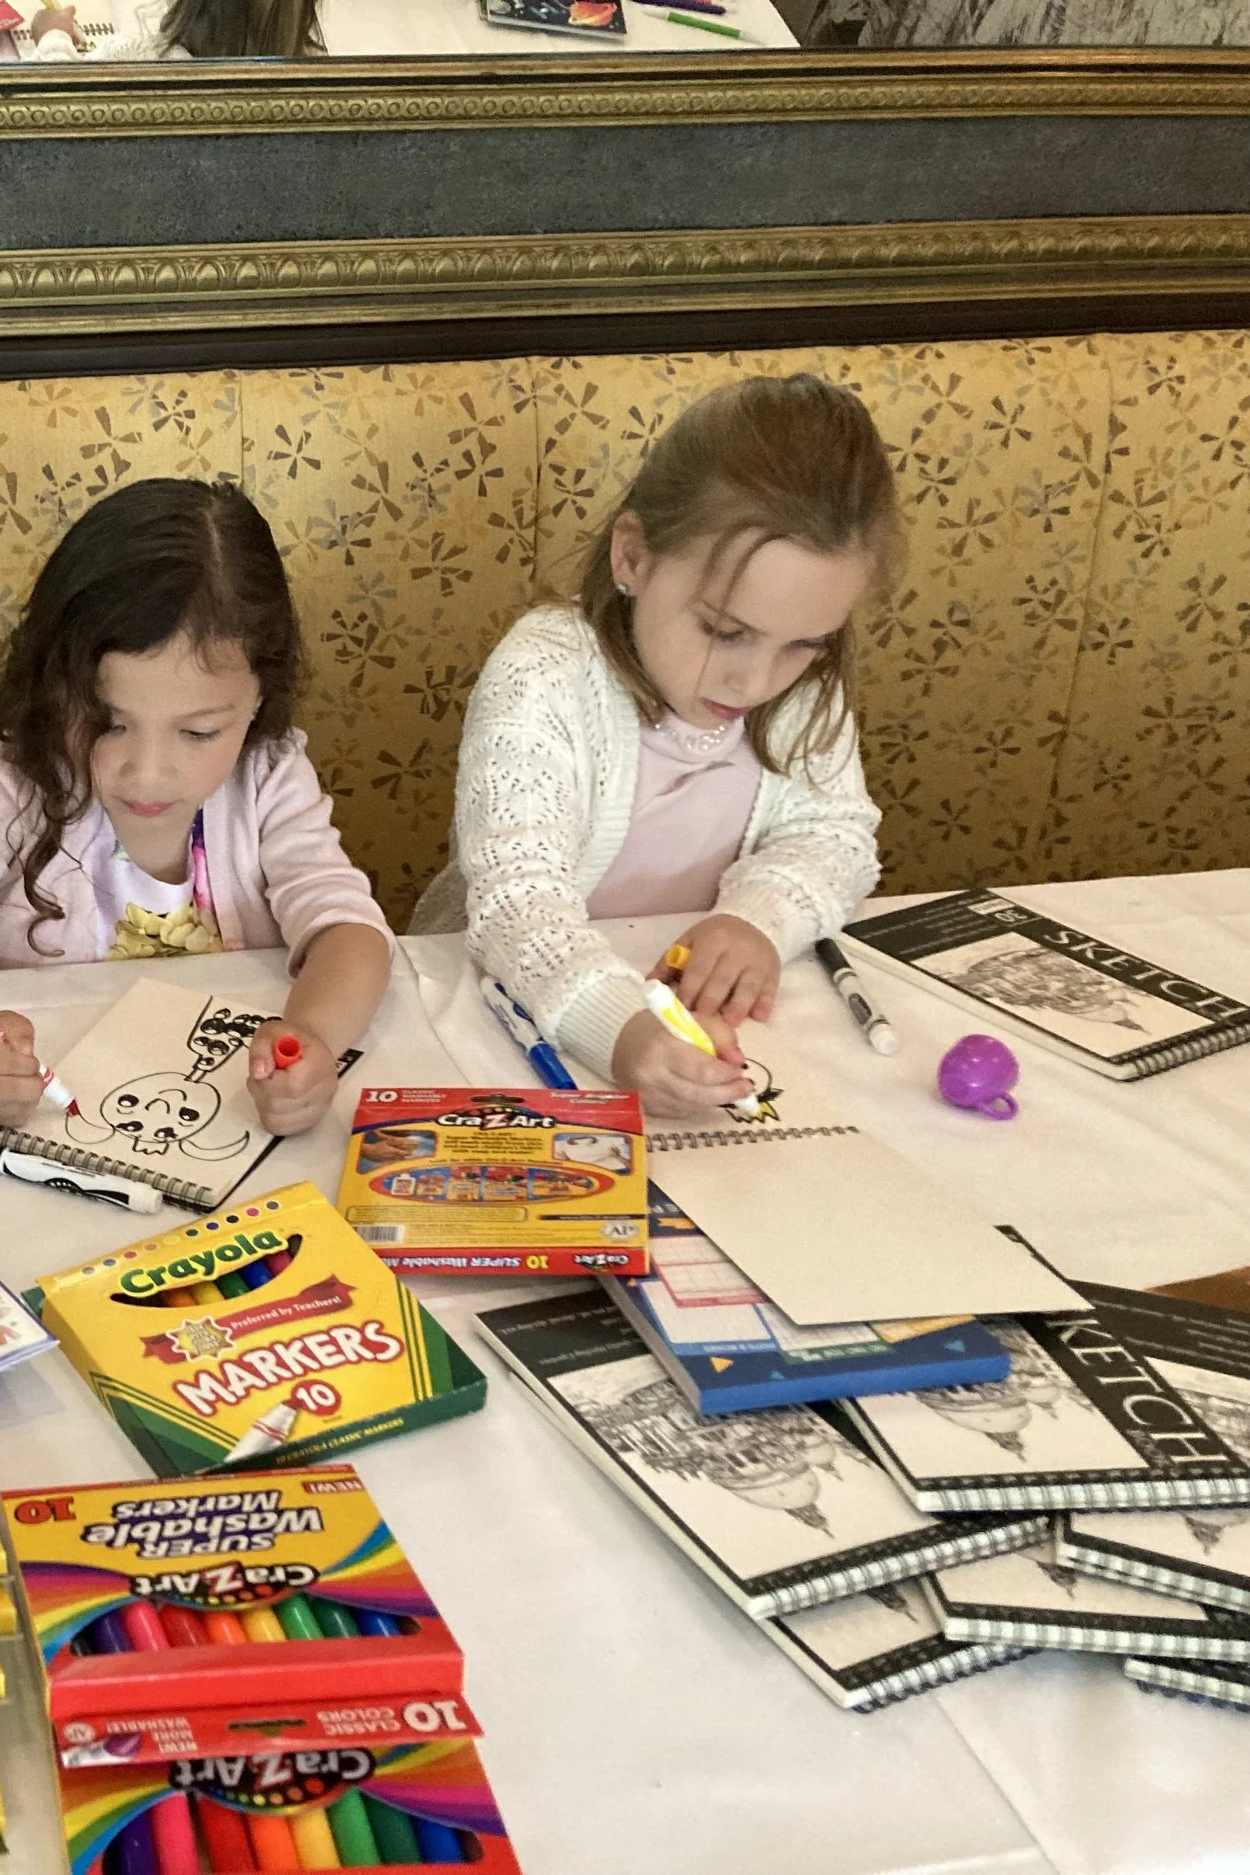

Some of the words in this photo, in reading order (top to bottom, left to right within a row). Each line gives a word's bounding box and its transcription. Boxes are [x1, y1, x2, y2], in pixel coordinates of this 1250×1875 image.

[1045, 929, 1250, 1019] SKETCH
[366, 1091, 398, 1103] 10
[121, 1231, 284, 1294] Crayola
[400, 1256, 467, 1268] Washable
[470, 1257, 520, 1267] SUPER
[526, 1254, 549, 1270] 10
[230, 1309, 277, 1330] Preferred
[278, 1305, 293, 1317] by
[175, 1322, 402, 1415] MARKERS
[296, 1384, 336, 1411] 10
[1047, 1318, 1229, 1463] KETCH
[308, 1480, 362, 1493] NEW!
[13, 1497, 76, 1525] 10
[113, 1491, 280, 1519] Markers
[82, 1509, 322, 1547] Washable
[136, 1534, 272, 1558] SUPER
[315, 1707, 395, 1723] COLORS
[402, 1700, 467, 1732] 10
[322, 1721, 402, 1736] CLASSIC
